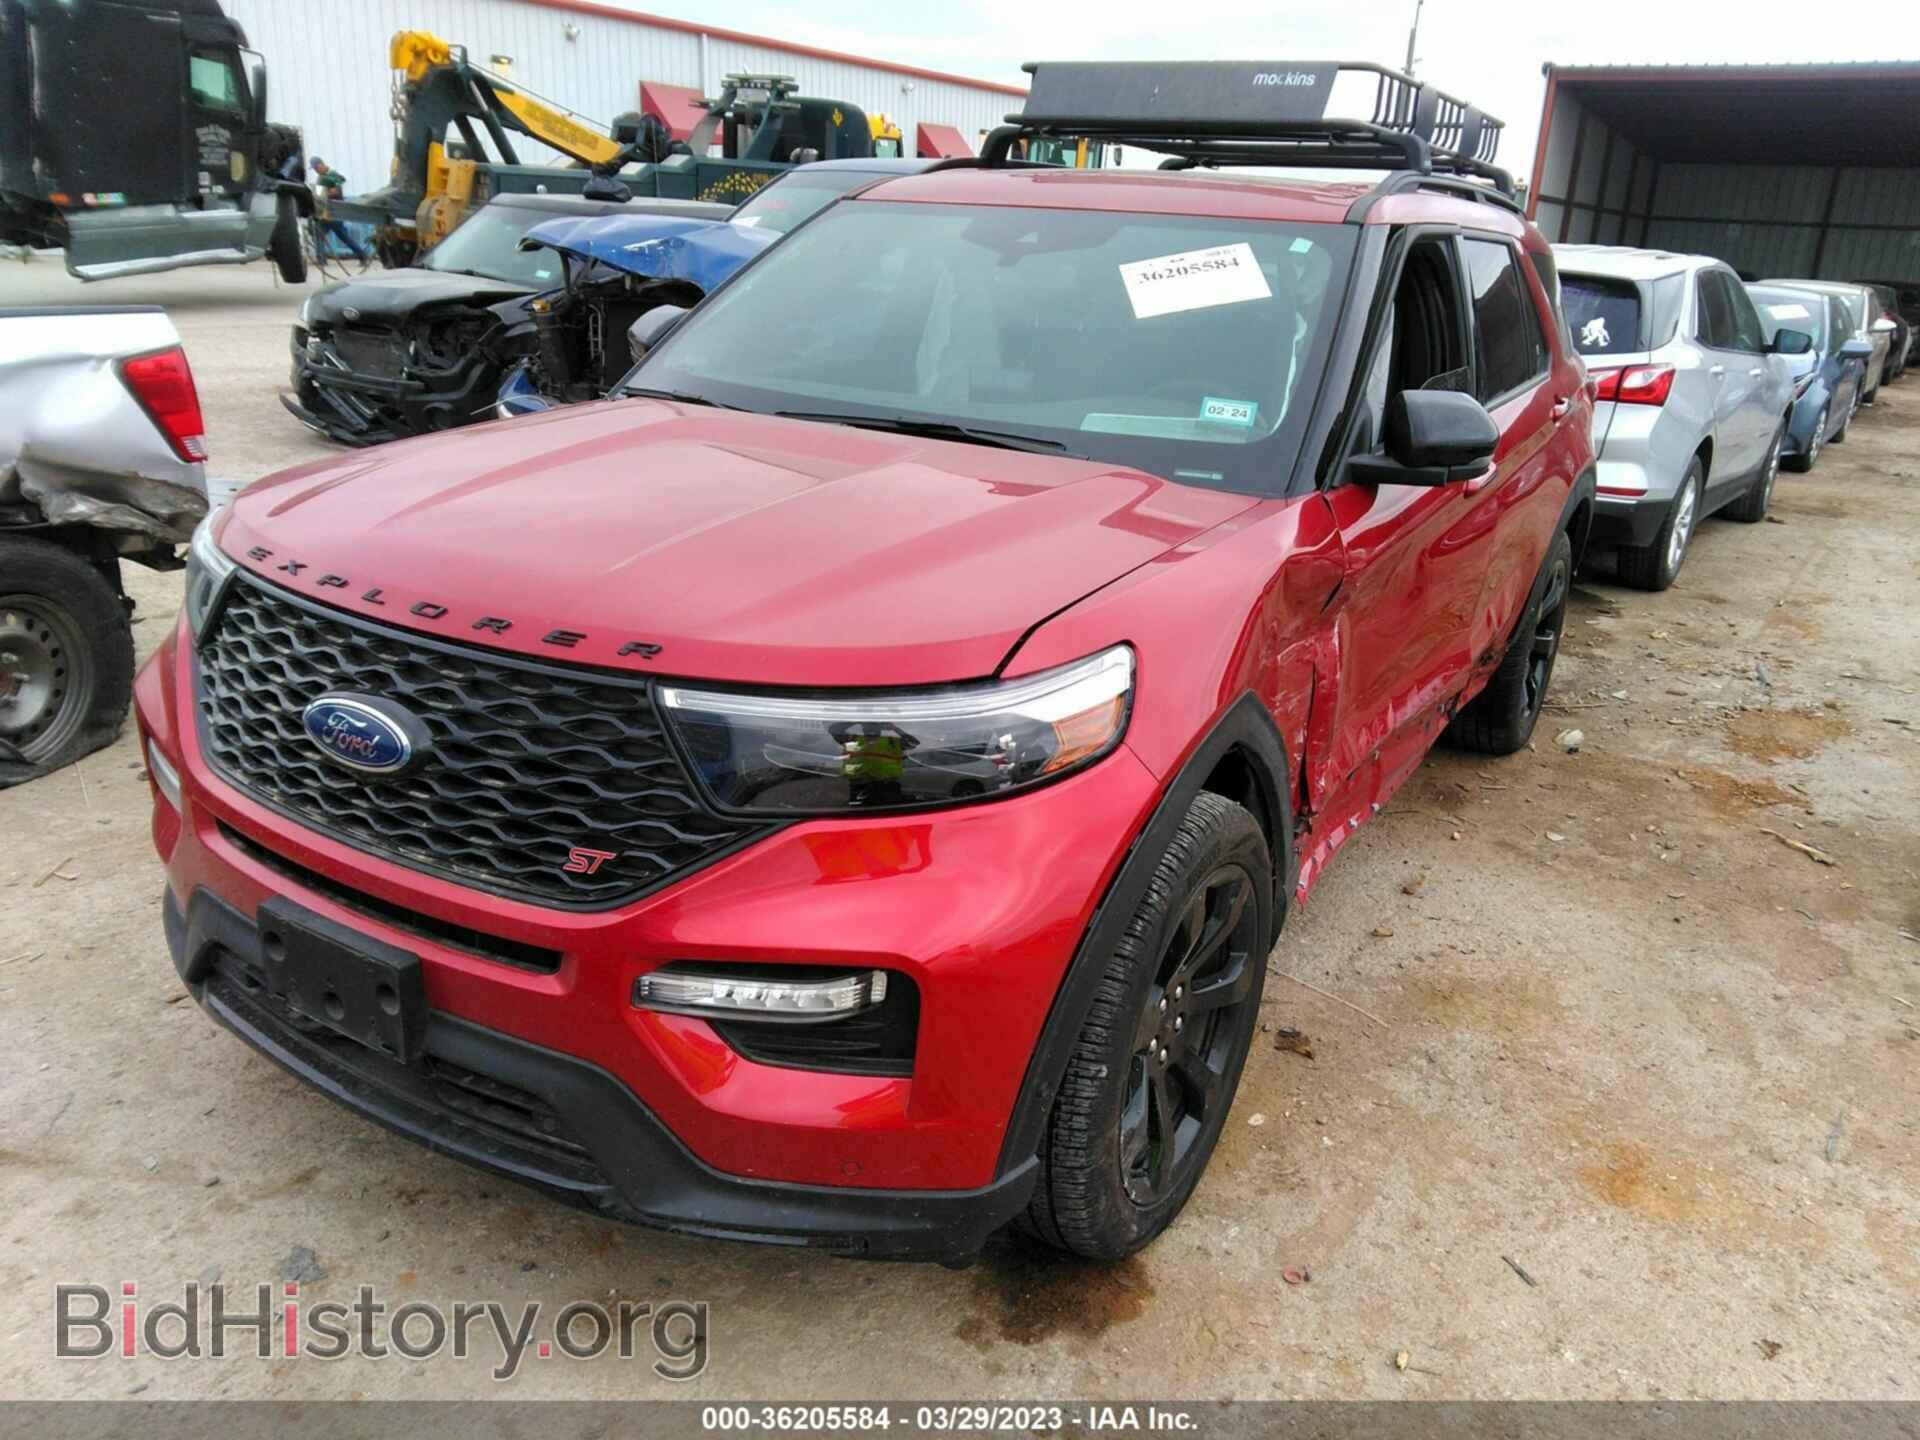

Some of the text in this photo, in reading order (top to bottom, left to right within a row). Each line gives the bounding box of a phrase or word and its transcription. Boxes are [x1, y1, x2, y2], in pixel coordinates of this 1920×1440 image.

[1252, 71, 1317, 86] mockins
[1138, 257, 1240, 284] 36205584
[246, 545, 663, 660] EXPLORER
[322, 711, 382, 759] Ford
[562, 846, 617, 875] ST
